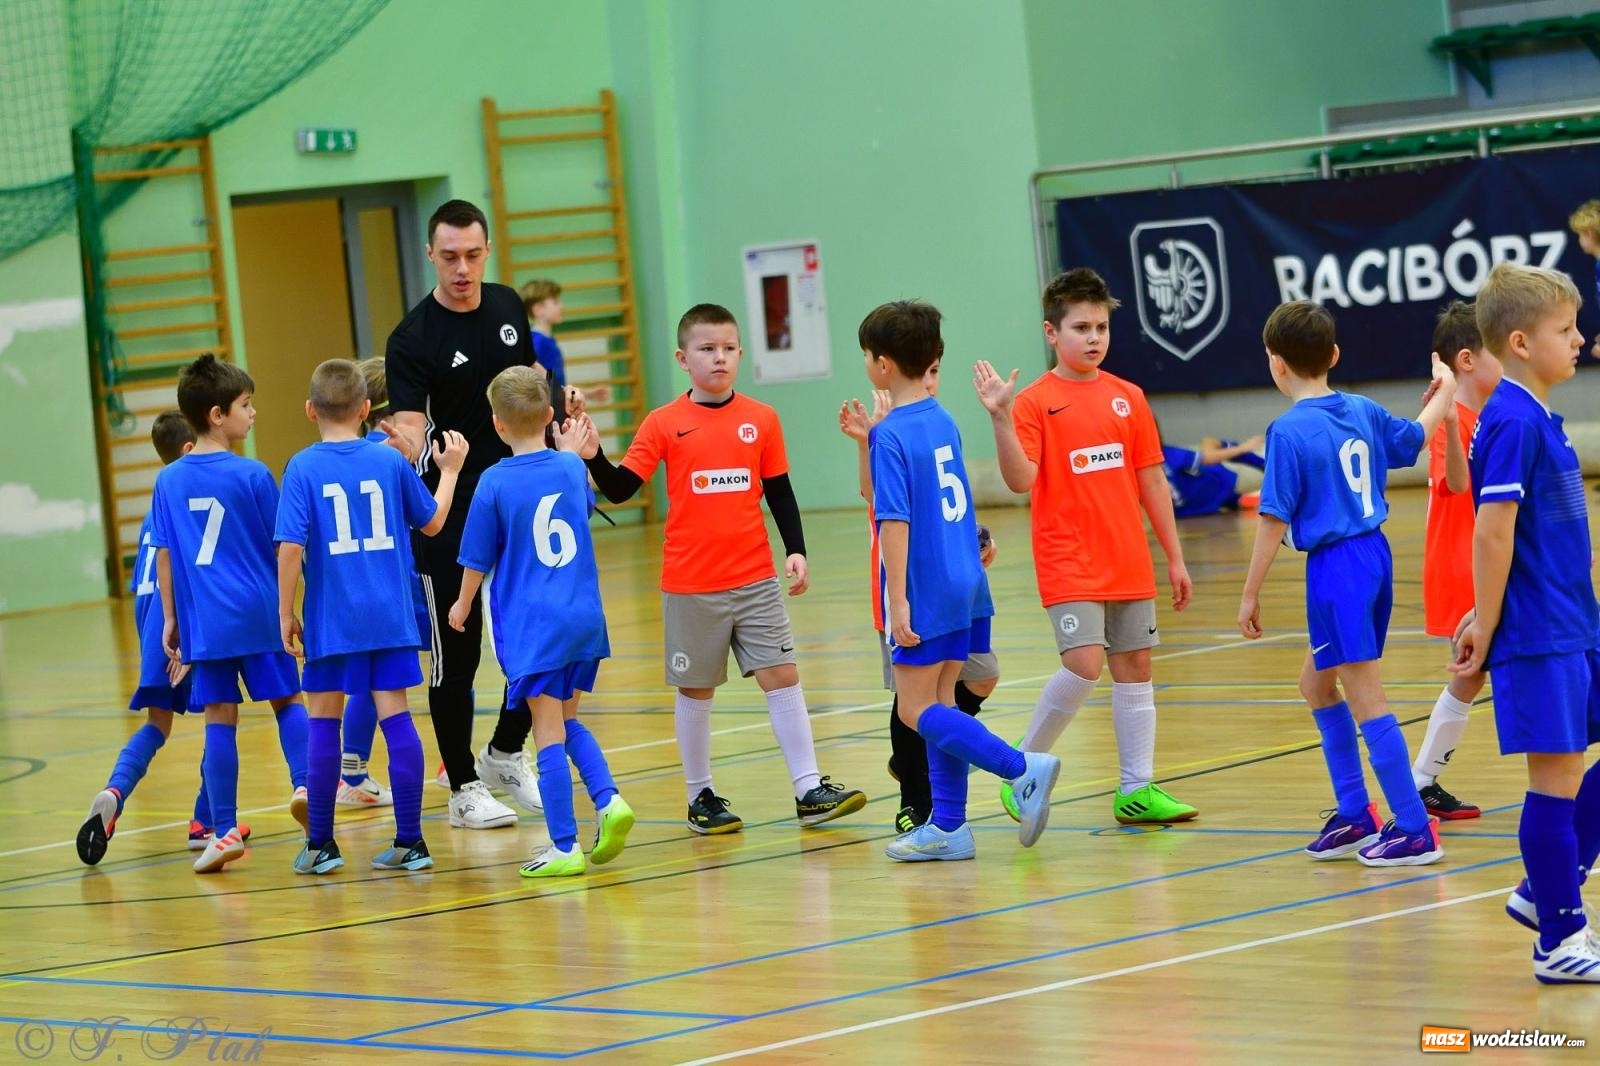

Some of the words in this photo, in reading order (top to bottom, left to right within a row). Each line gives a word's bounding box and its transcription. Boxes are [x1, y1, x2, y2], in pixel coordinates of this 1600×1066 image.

[711, 475, 749, 486] PAKON
[934, 444, 968, 523] 5
[1091, 450, 1122, 463] PAKO
[1338, 437, 1375, 519] 9
[188, 497, 226, 566] 7
[322, 479, 395, 556] 11
[532, 492, 578, 568] 6
